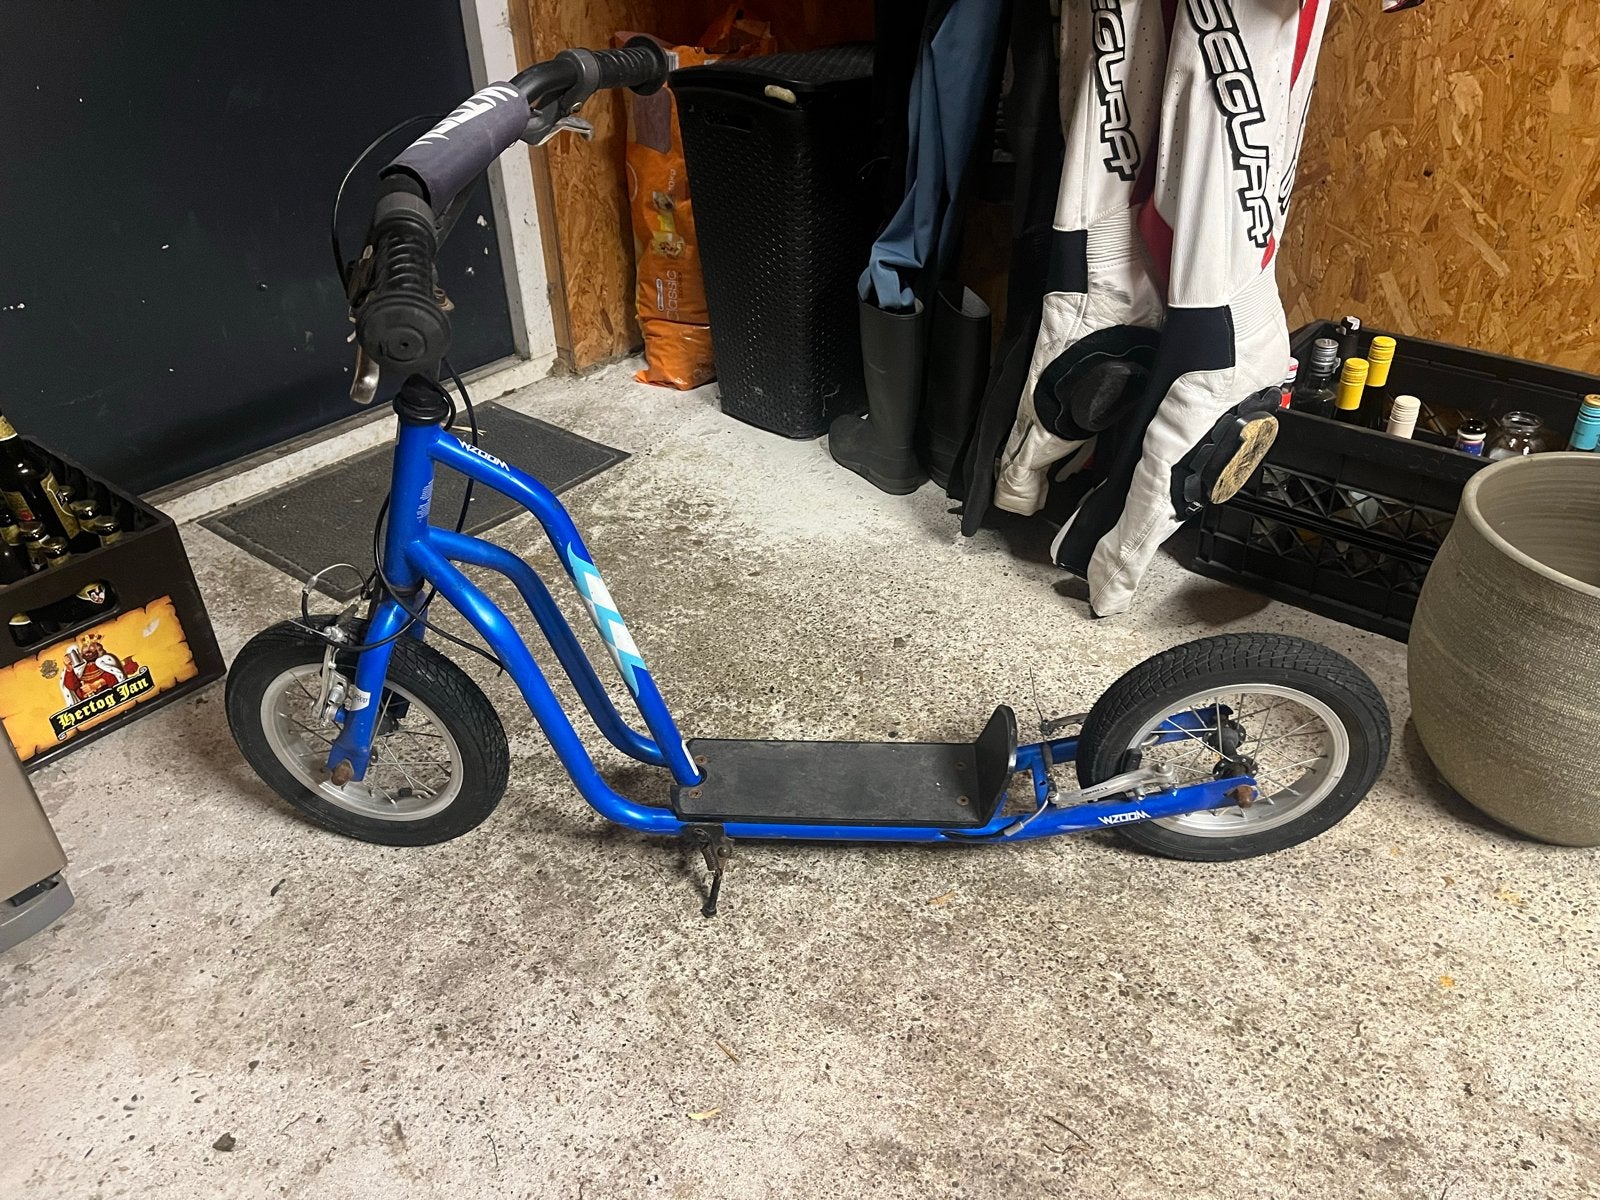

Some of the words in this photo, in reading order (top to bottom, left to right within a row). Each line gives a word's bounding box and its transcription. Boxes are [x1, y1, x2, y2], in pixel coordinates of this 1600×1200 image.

[1089, 0, 1140, 178] GURA
[1188, 0, 1272, 246] SEGURA
[456, 437, 510, 472] WZOOM
[57, 694, 116, 729] Hertog
[116, 678, 149, 701] Jan
[1097, 809, 1151, 824] WZOOM
